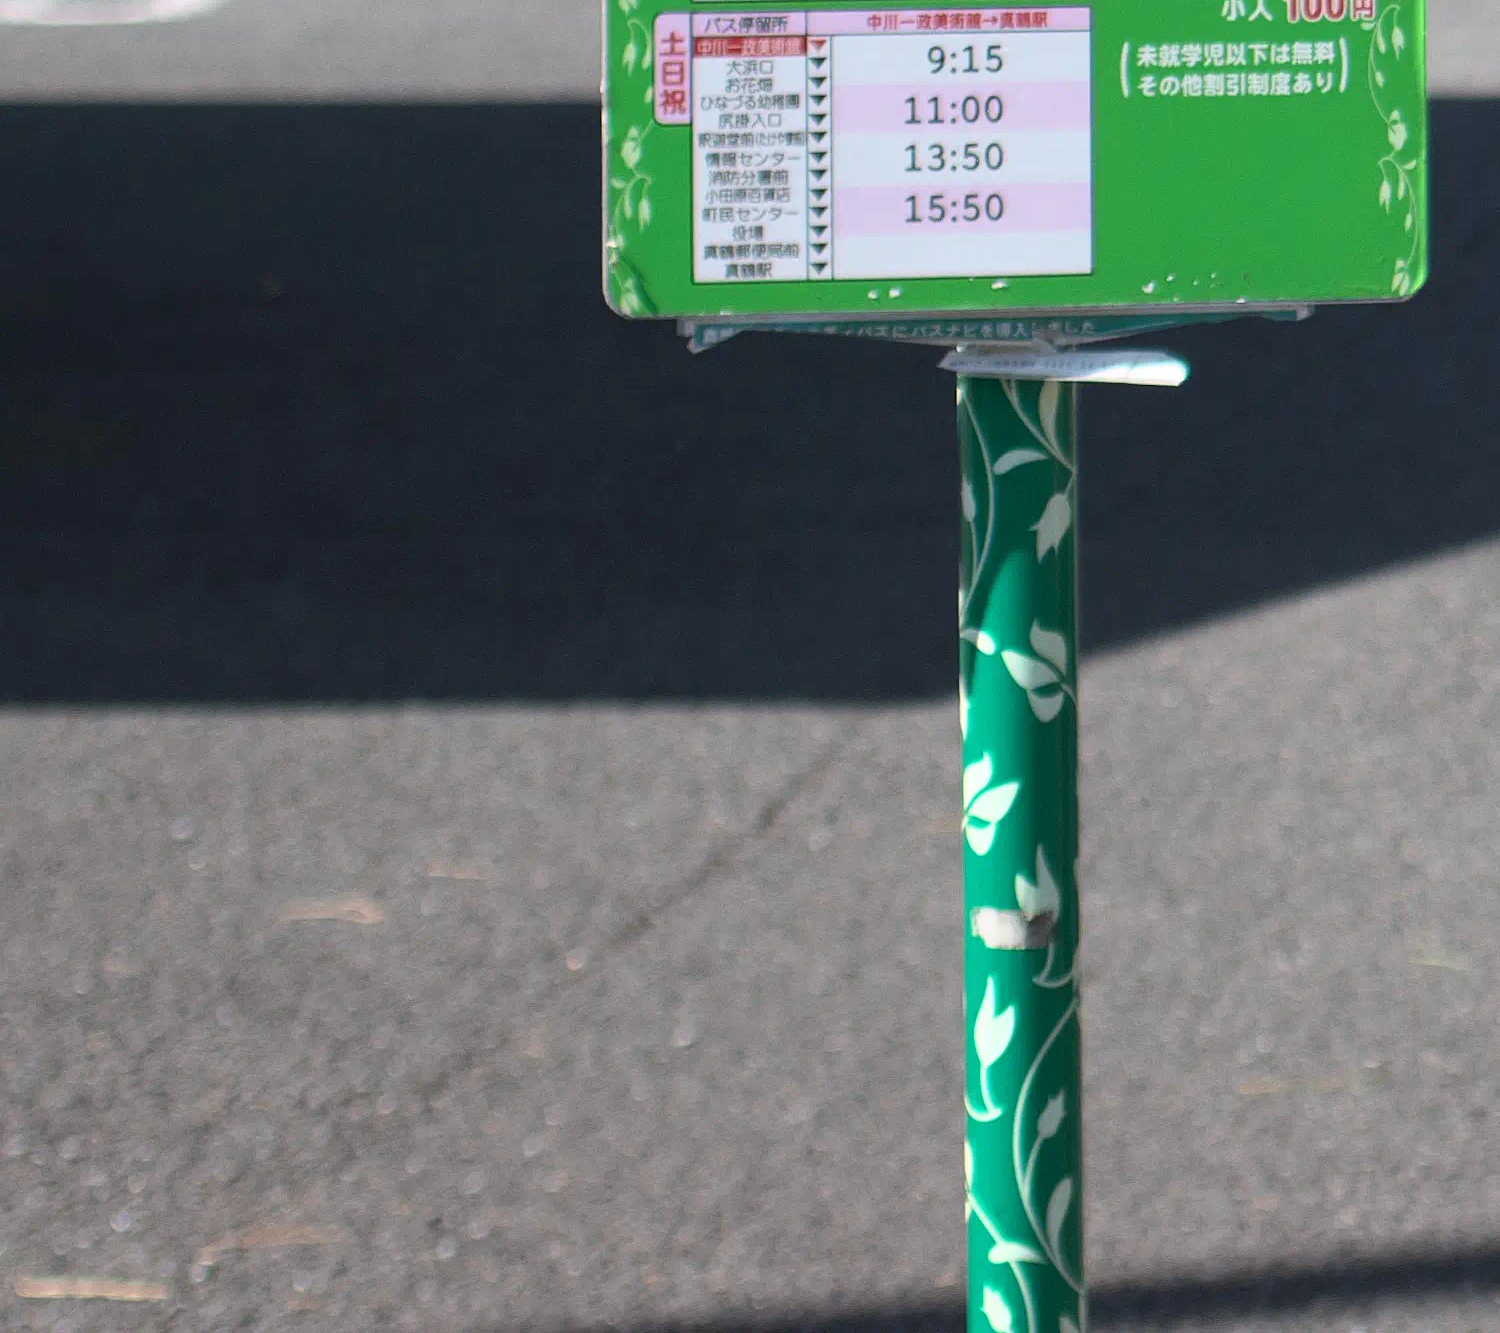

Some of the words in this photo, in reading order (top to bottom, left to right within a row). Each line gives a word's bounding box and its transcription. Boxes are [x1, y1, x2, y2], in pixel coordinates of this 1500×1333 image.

[705, 17, 788, 33] バス停留所
[697, 39, 801, 55] 中川一政美術館
[727, 60, 773, 75] 大浜口
[928, 45, 1003, 74] 9:15
[700, 95, 799, 110] ひなづる幼稚園
[904, 95, 1003, 125] 11:00
[705, 152, 800, 167] 情報センター
[904, 143, 1004, 172] 13:50
[702, 207, 798, 222] 町民センター
[905, 194, 1005, 223] 15:50
[725, 263, 772, 279] 真鶴駅
